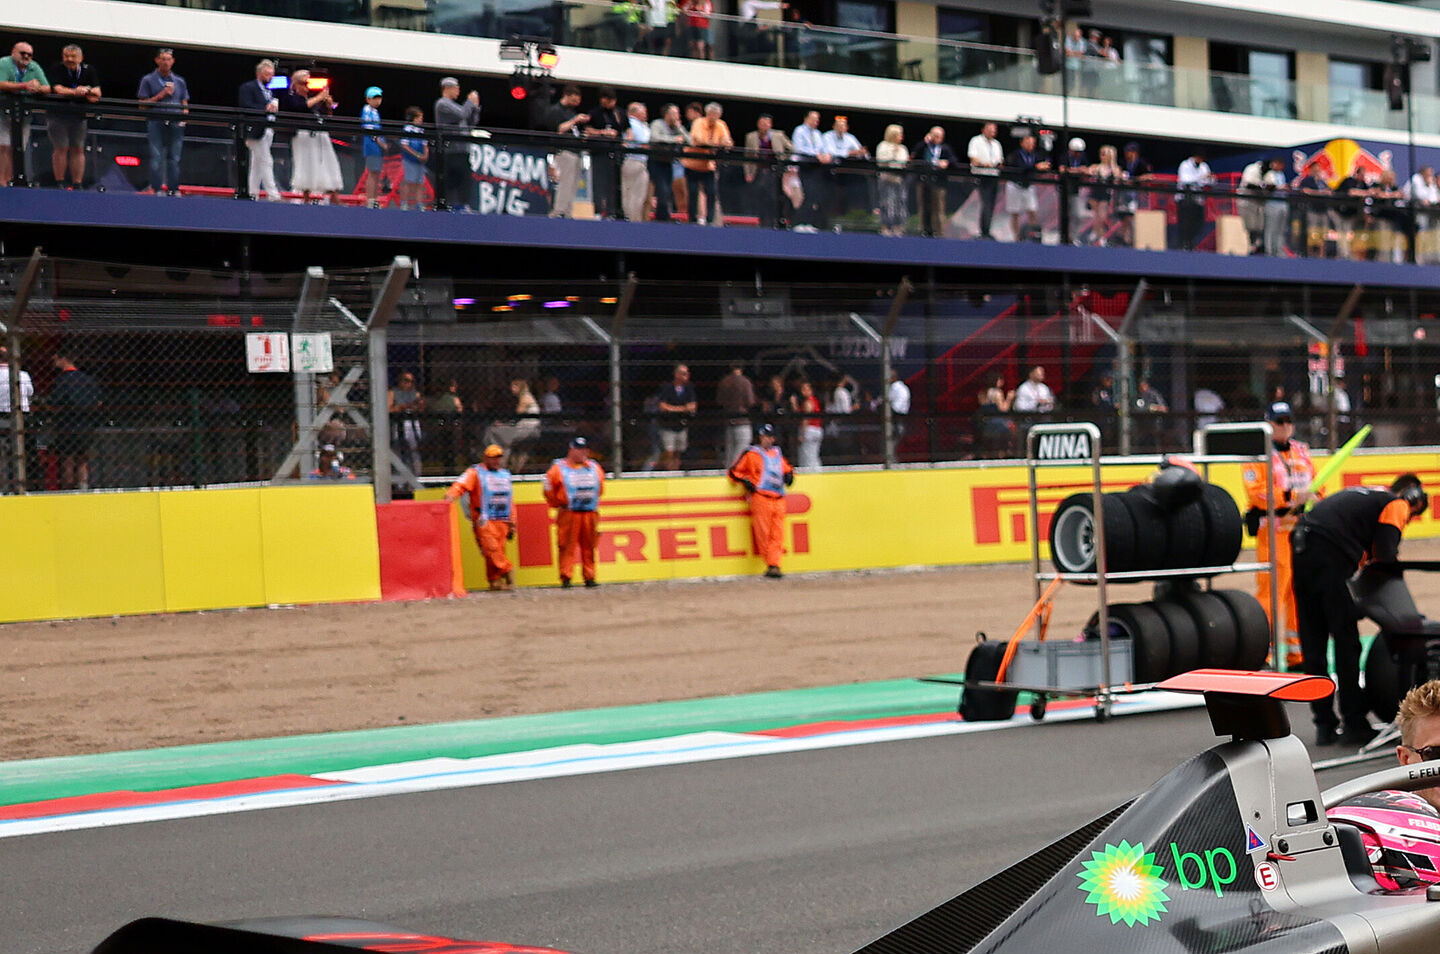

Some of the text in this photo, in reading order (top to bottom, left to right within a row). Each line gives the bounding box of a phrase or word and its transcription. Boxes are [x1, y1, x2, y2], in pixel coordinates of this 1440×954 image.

[1039, 433, 1090, 459] NINA
[1408, 770, 1418, 780] E.
[1169, 842, 1237, 898] bp
[1260, 866, 1275, 887] E
